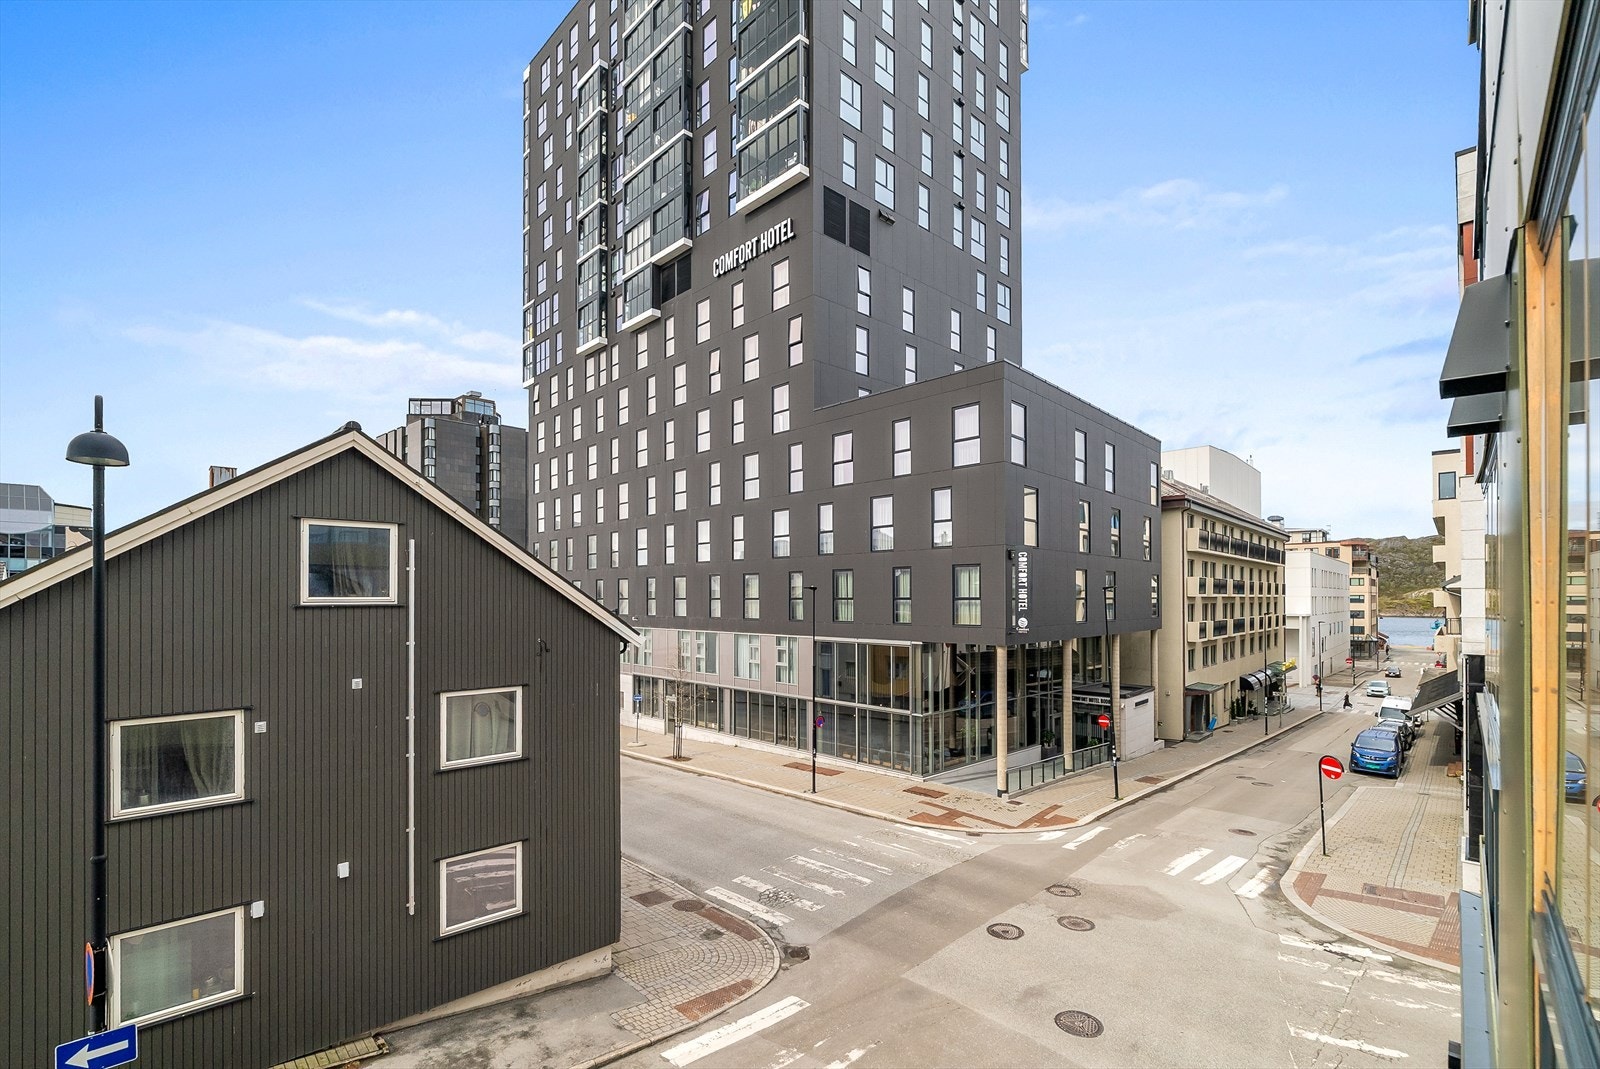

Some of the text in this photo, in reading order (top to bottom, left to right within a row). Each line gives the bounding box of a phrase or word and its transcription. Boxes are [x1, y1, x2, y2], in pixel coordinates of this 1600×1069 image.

[713, 217, 794, 278] COMFORT HOTEL
[1018, 551, 1028, 612] COMFORT HOTEL
